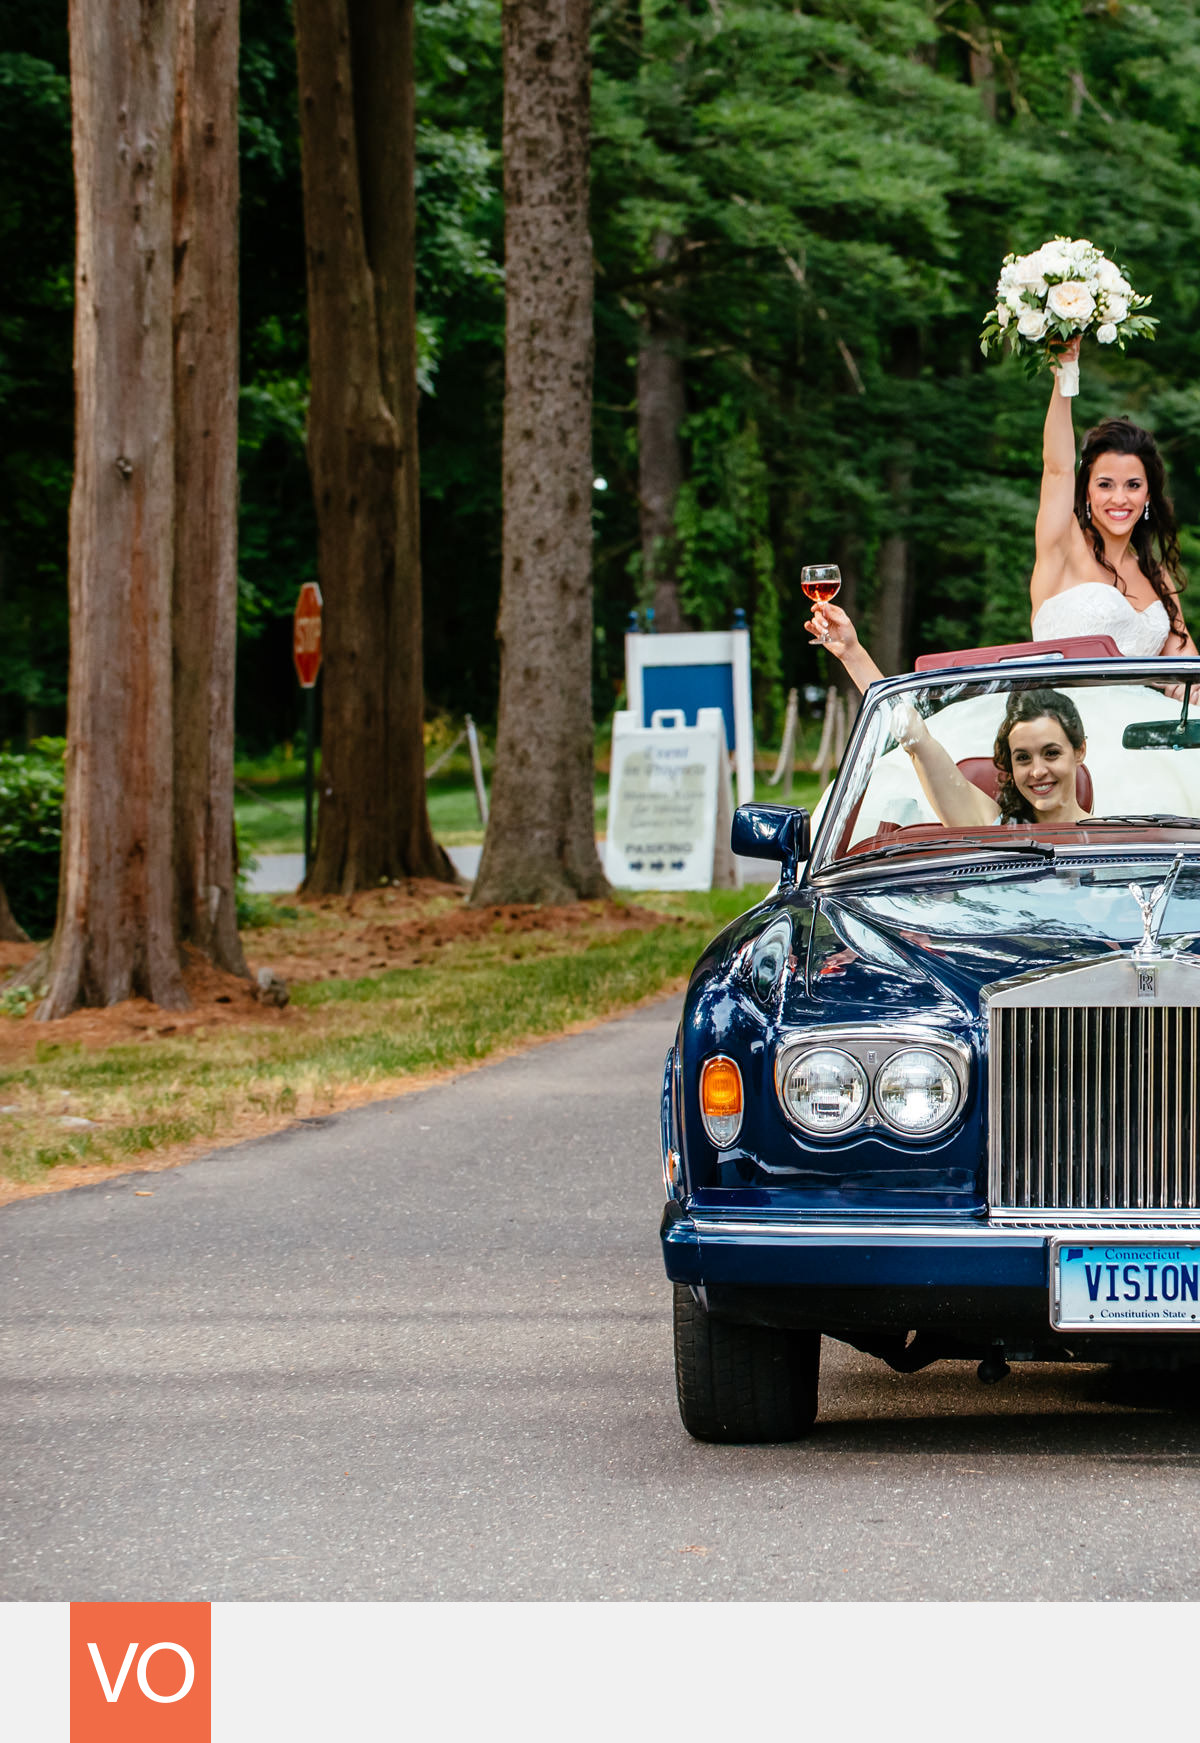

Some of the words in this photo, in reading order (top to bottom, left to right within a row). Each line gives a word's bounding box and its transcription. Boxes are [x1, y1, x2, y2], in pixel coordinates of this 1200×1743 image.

[296, 616, 322, 654] STOP
[624, 842, 693, 854] PARKING
[1104, 1248, 1180, 1260] Connecticut
[1084, 1264, 1199, 1301] VISION
[1100, 1309, 1160, 1319] Constitution
[1162, 1309, 1187, 1319] State
